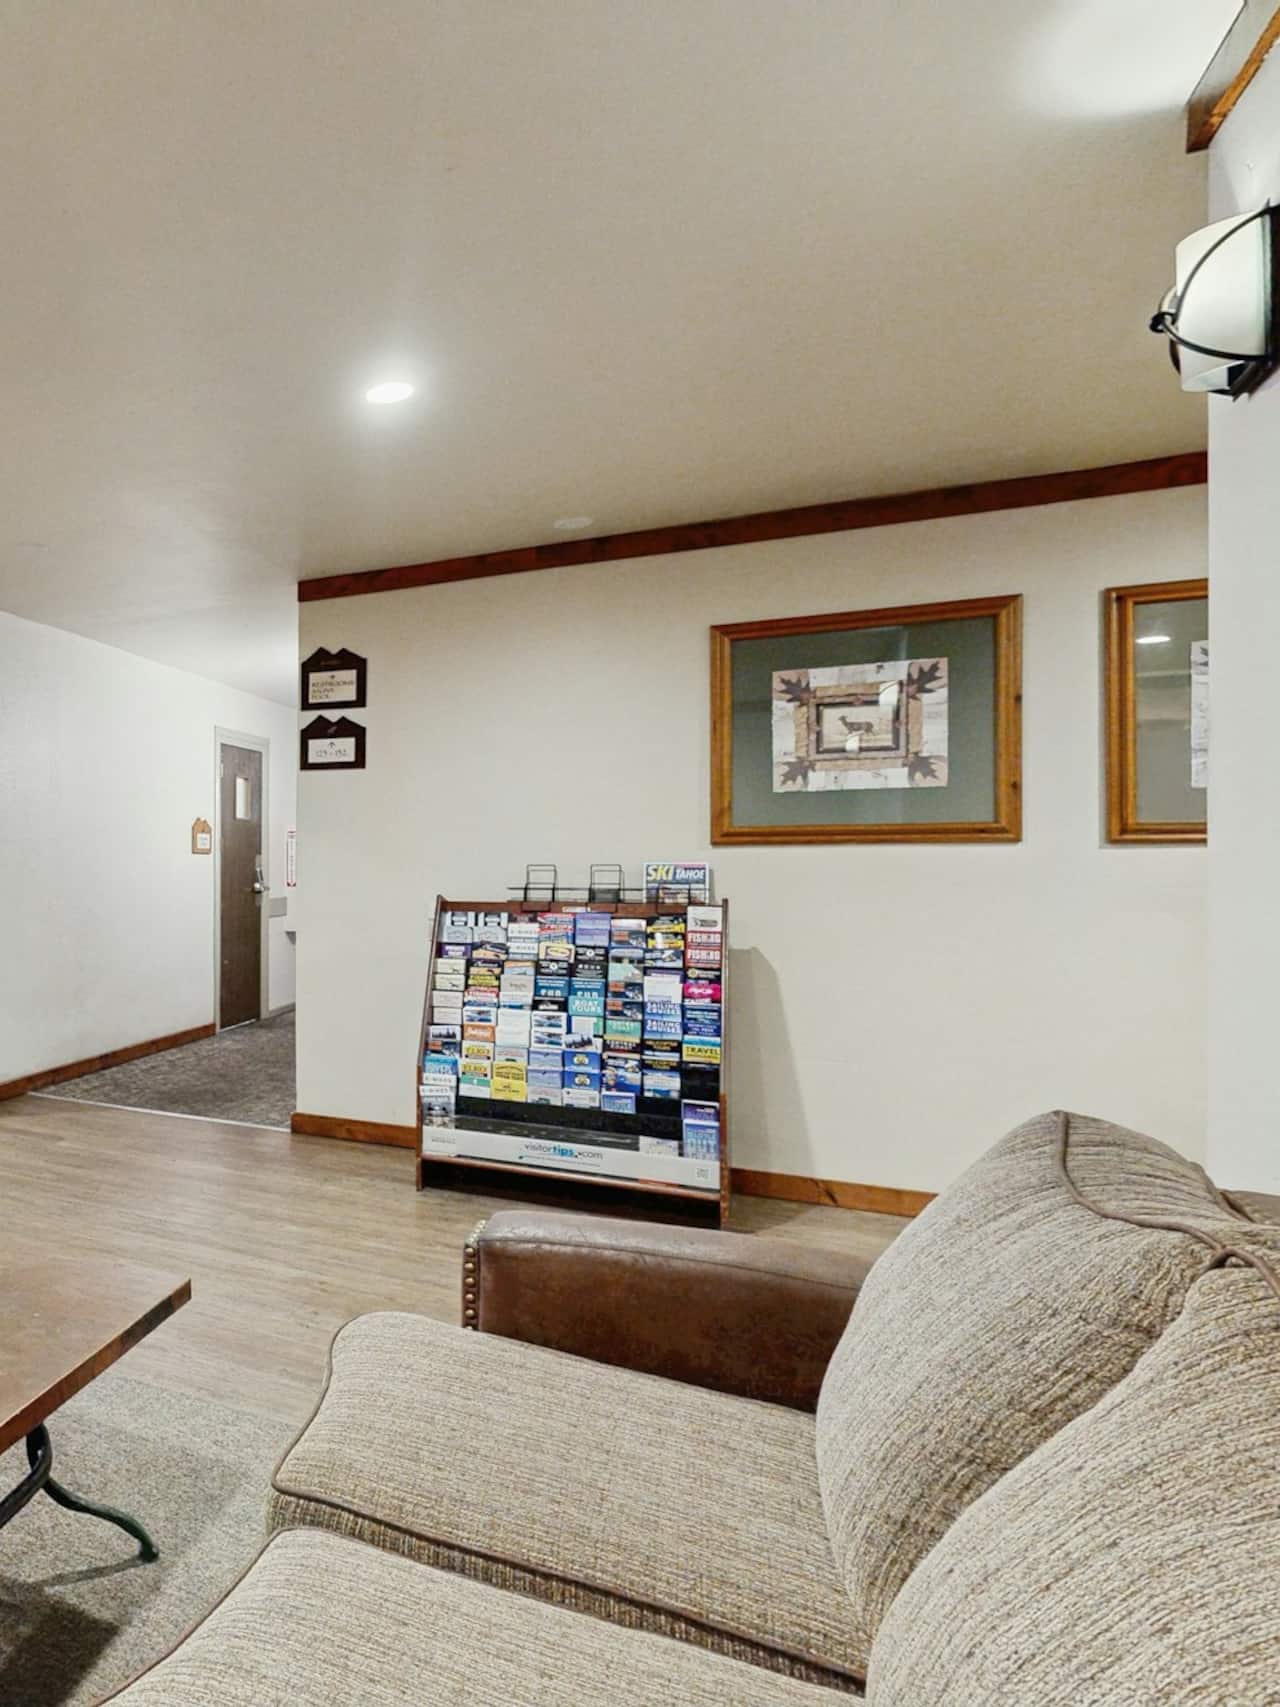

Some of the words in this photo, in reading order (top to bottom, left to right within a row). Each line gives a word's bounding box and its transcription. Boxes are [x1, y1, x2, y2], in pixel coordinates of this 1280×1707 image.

[647, 864, 674, 880] SKI
[675, 868, 705, 879] TAHOE
[524, 1144, 603, 1159] visitortips.com
